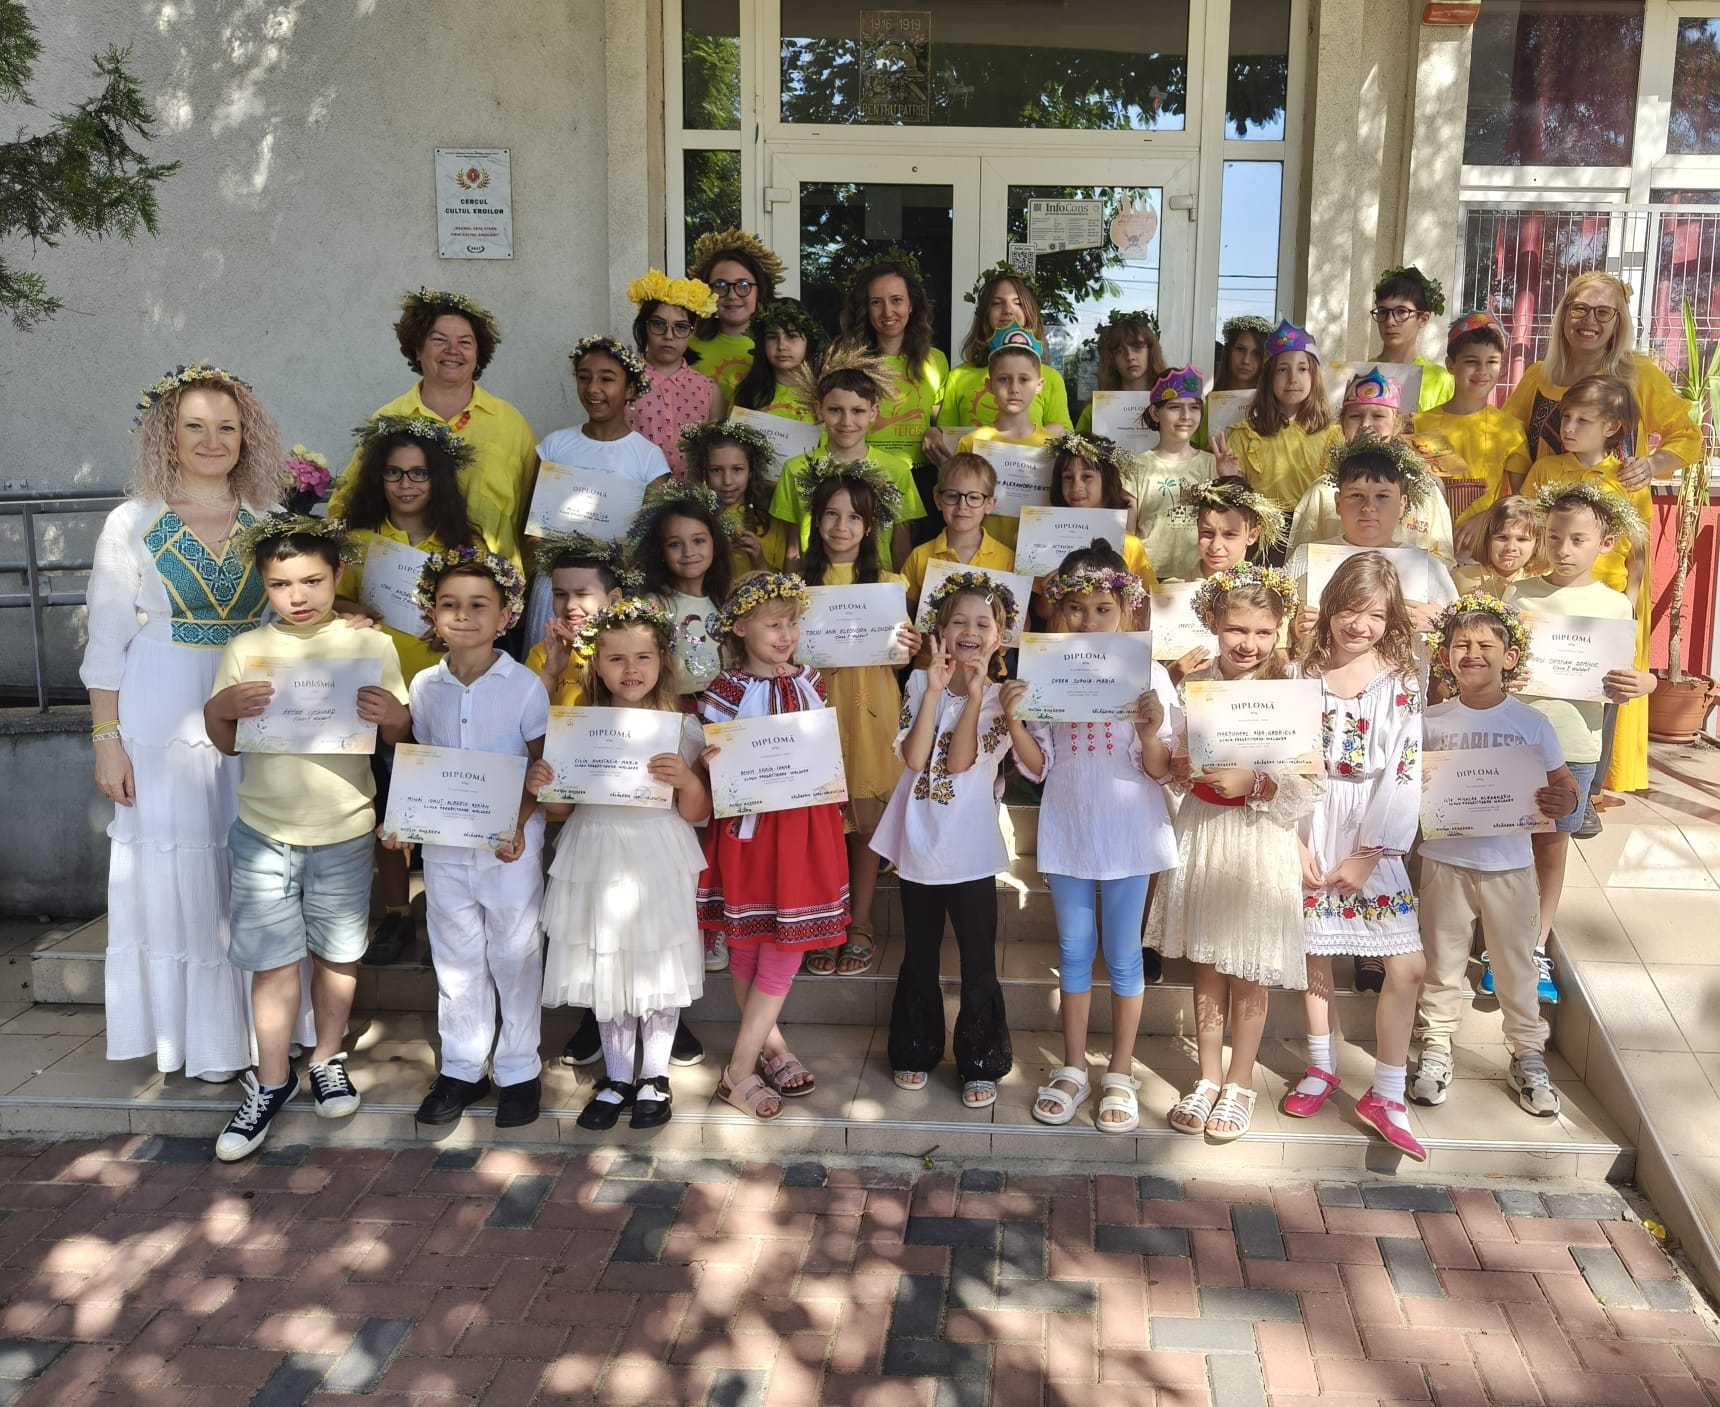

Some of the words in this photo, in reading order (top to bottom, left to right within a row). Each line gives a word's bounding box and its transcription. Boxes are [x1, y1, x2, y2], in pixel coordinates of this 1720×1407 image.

[1046, 202, 1089, 213] InfoCons
[1230, 701, 1276, 711] DIPLOMĂ
[752, 734, 795, 748] DIPLOMĂ
[442, 770, 486, 783] DIPLOMĂ
[1456, 767, 1500, 778] DIPLOMĂ
